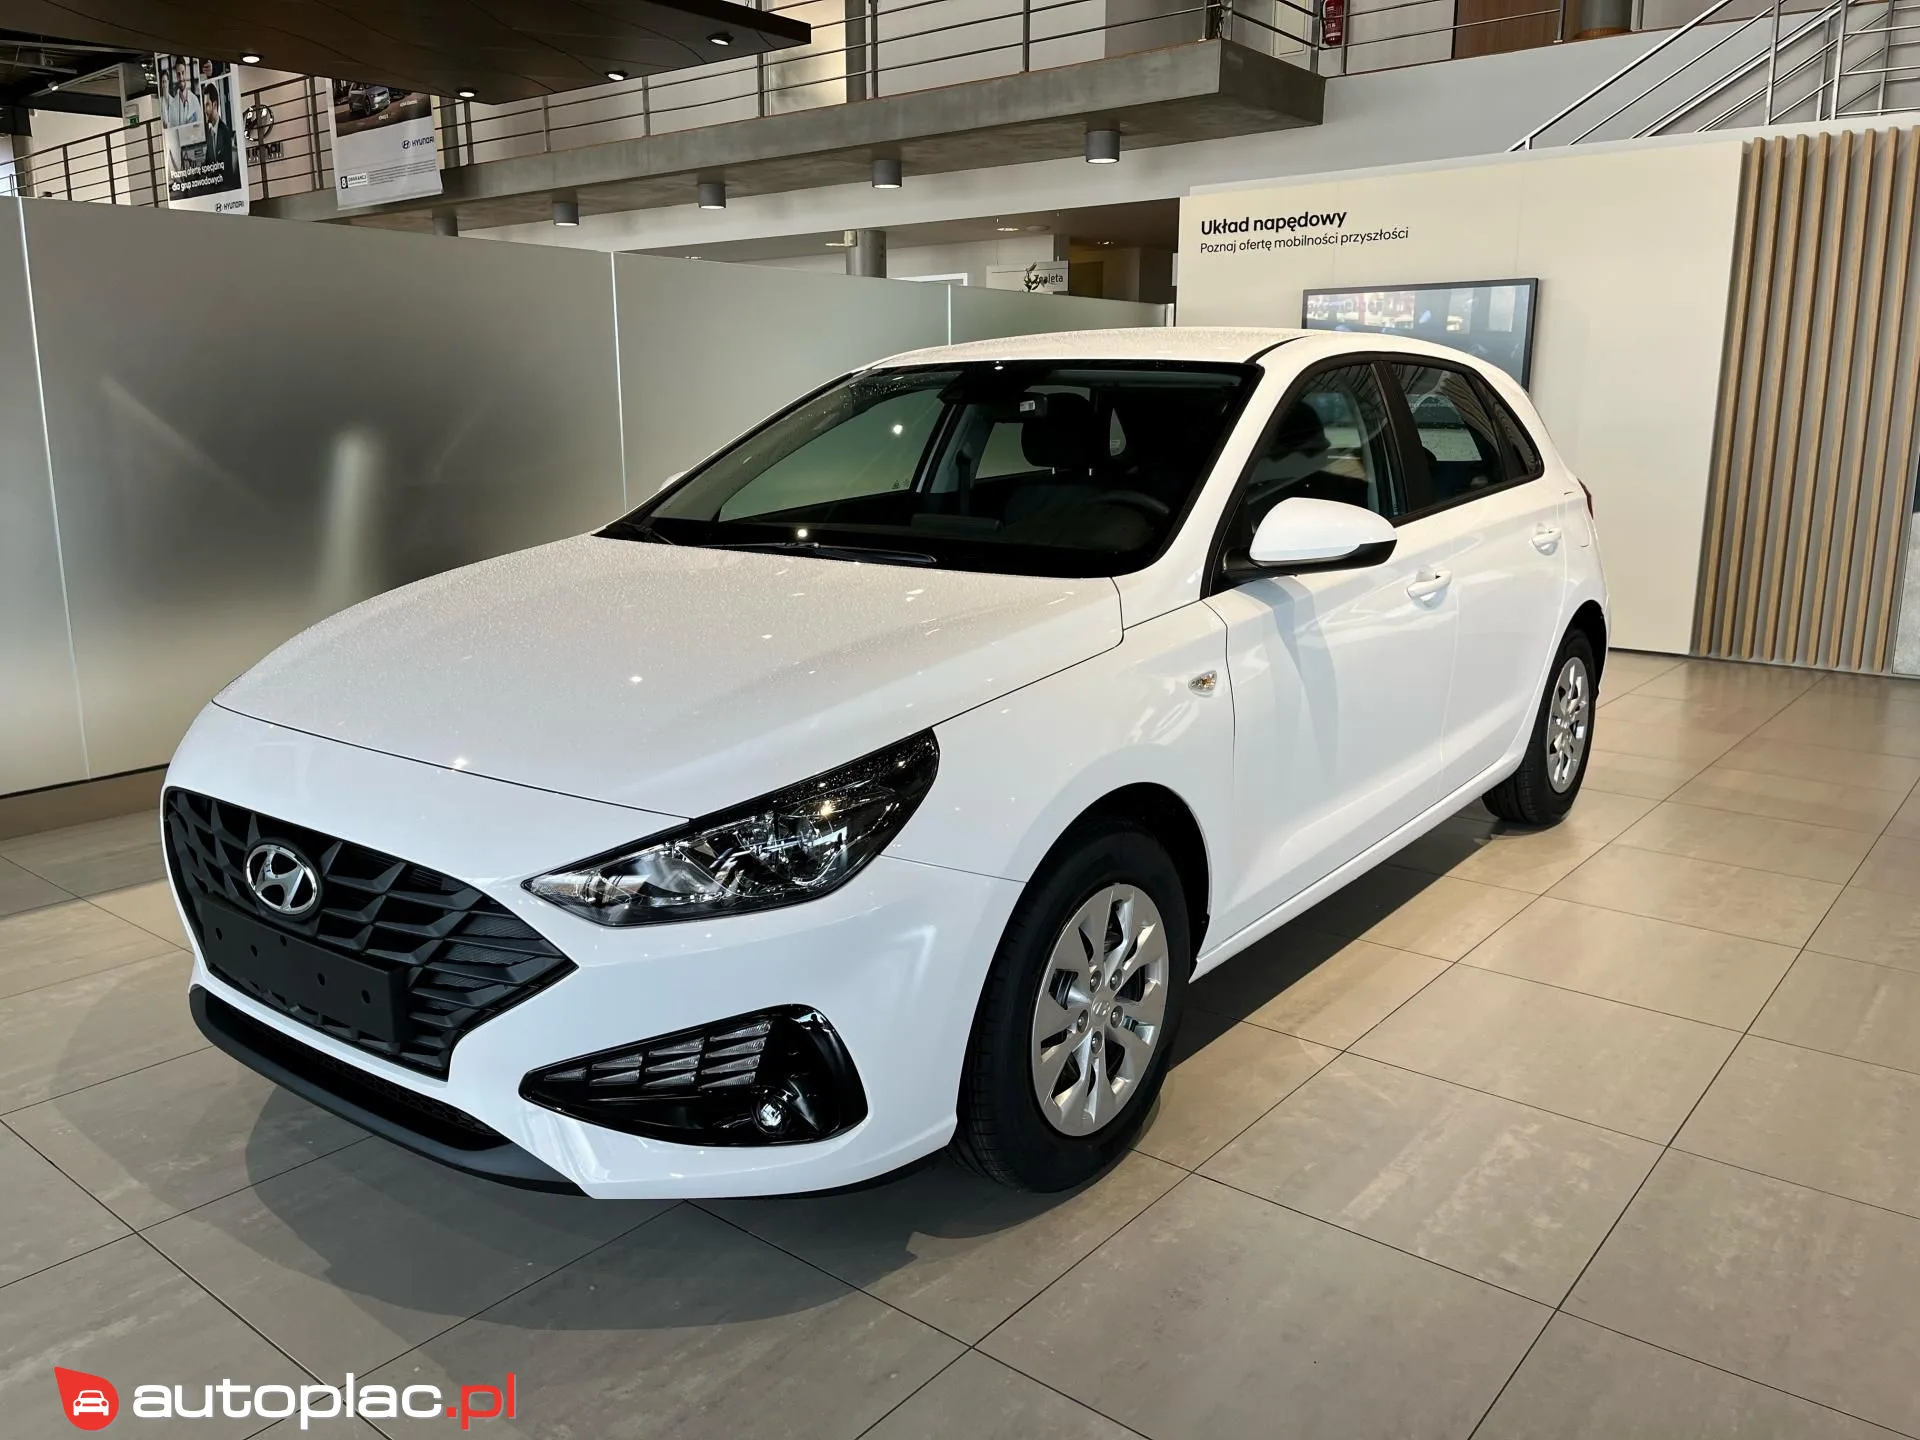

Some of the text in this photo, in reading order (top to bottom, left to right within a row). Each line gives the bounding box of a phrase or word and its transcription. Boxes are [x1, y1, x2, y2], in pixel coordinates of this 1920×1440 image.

[411, 136, 435, 147] HYUNDAI
[171, 161, 225, 179] Poznaj ofertę specjalną
[172, 174, 224, 192] dla grup zawodowych
[223, 201, 244, 211] HYUNDAI
[1201, 211, 1347, 235] Układ napędowy
[1200, 227, 1409, 253] Poznaj ofertę mobilności przyszłości
